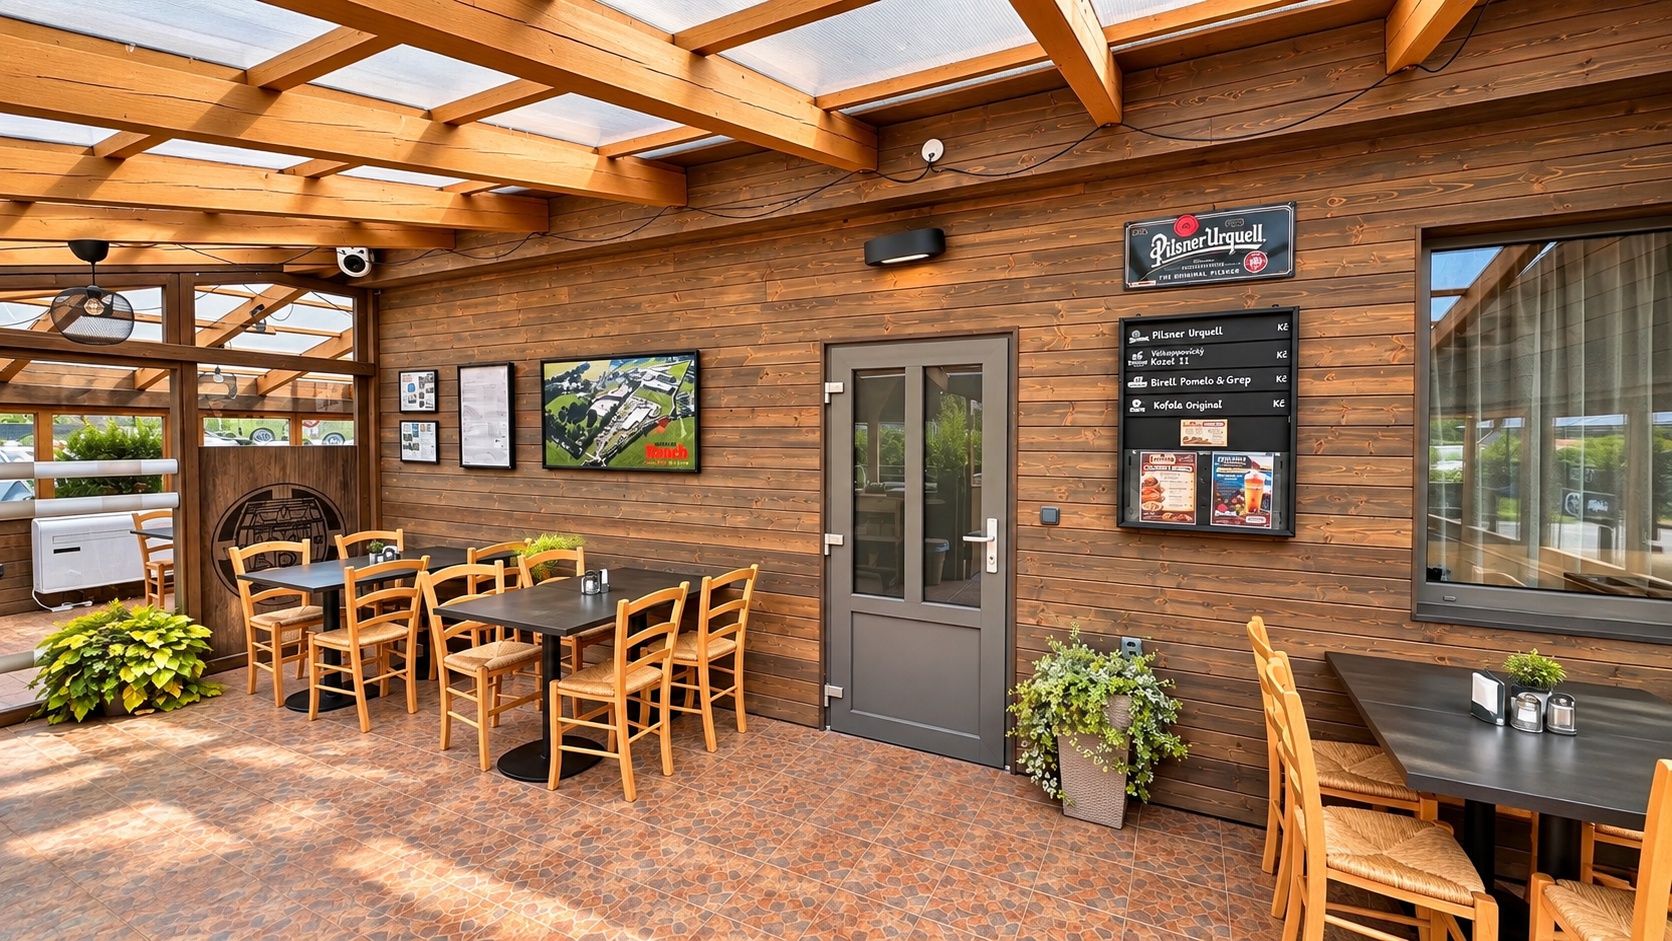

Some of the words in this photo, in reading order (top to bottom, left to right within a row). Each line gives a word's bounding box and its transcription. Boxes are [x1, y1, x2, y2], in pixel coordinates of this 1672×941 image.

[1150, 232, 1206, 268] Pilsner
[1205, 223, 1266, 256] Urquell
[1152, 329, 1185, 340] Pilsner
[1151, 357, 1175, 366] Kozel
[1179, 357, 1189, 365] 11
[1151, 377, 1177, 387] Birell
[1180, 376, 1214, 386] Pomelo
[1216, 376, 1224, 385] &
[1226, 376, 1251, 387] Grep
[1153, 401, 1183, 410] Kofola
[1186, 400, 1223, 412] Original
